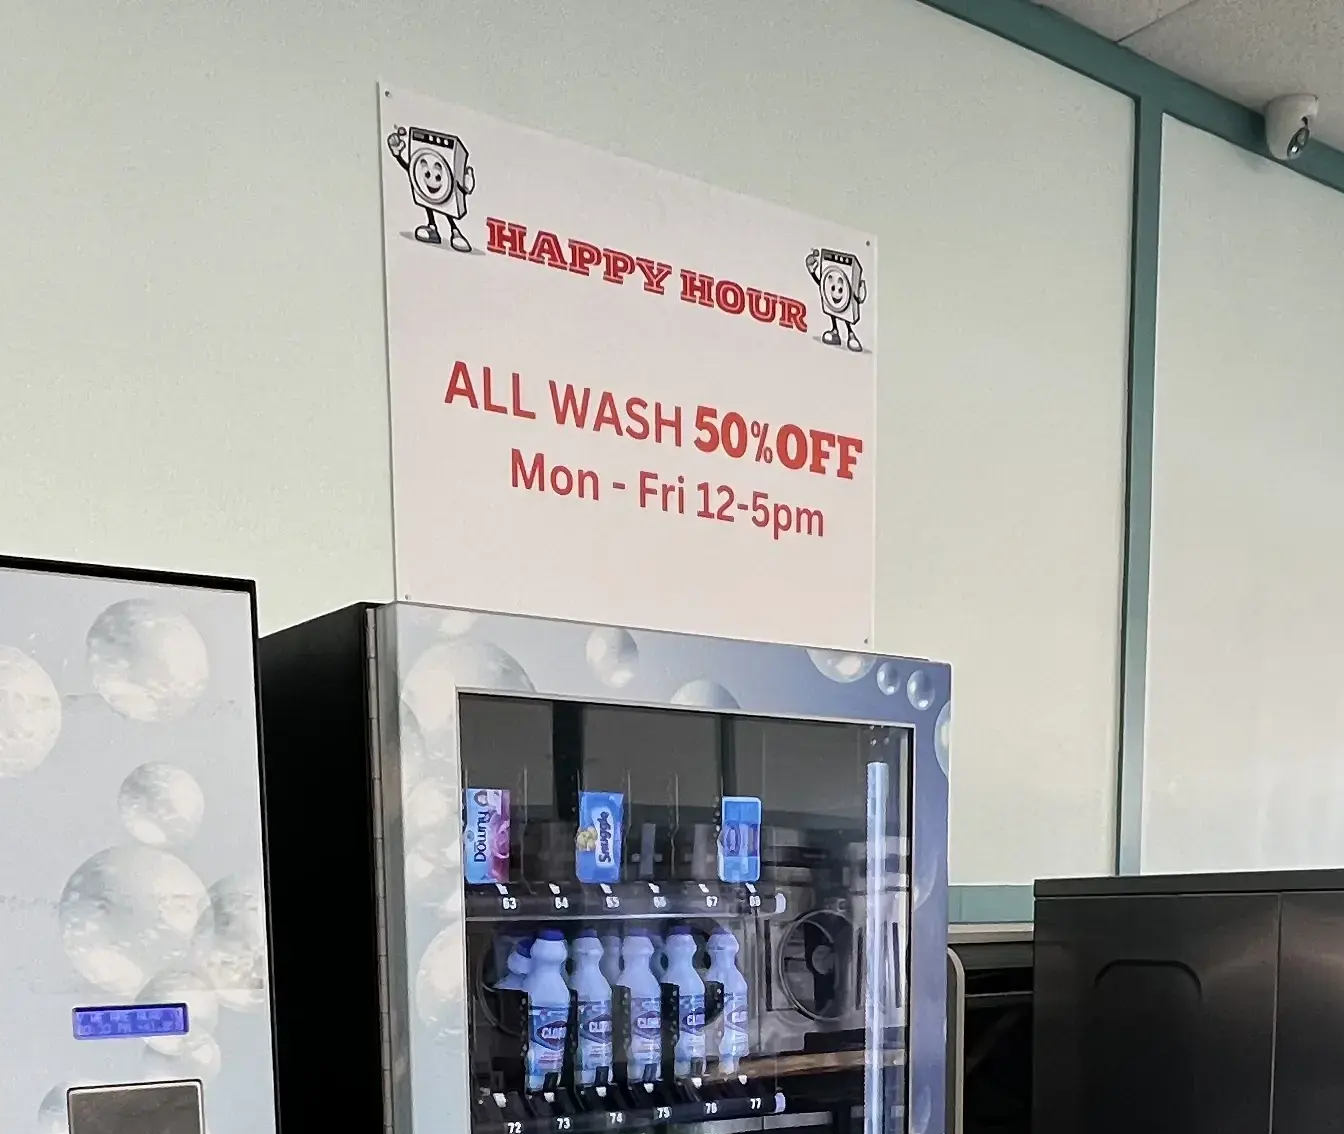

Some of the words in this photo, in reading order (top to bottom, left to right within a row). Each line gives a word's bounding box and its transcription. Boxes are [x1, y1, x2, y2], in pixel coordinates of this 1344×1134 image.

[486, 217, 673, 296] HAPPY
[680, 269, 808, 333] HOUR
[444, 360, 536, 420] ALL
[549, 379, 683, 448] WASH
[511, 448, 599, 501] Mon
[639, 470, 685, 514] Fri
[696, 481, 824, 539] 12-5pm
[474, 811, 490, 863] Downy
[598, 811, 611, 863] Snuggle
[508, 1121, 523, 1134] 72
[556, 1117, 571, 1130] 73
[609, 1112, 624, 1125] 74
[749, 1098, 762, 1110] 77
